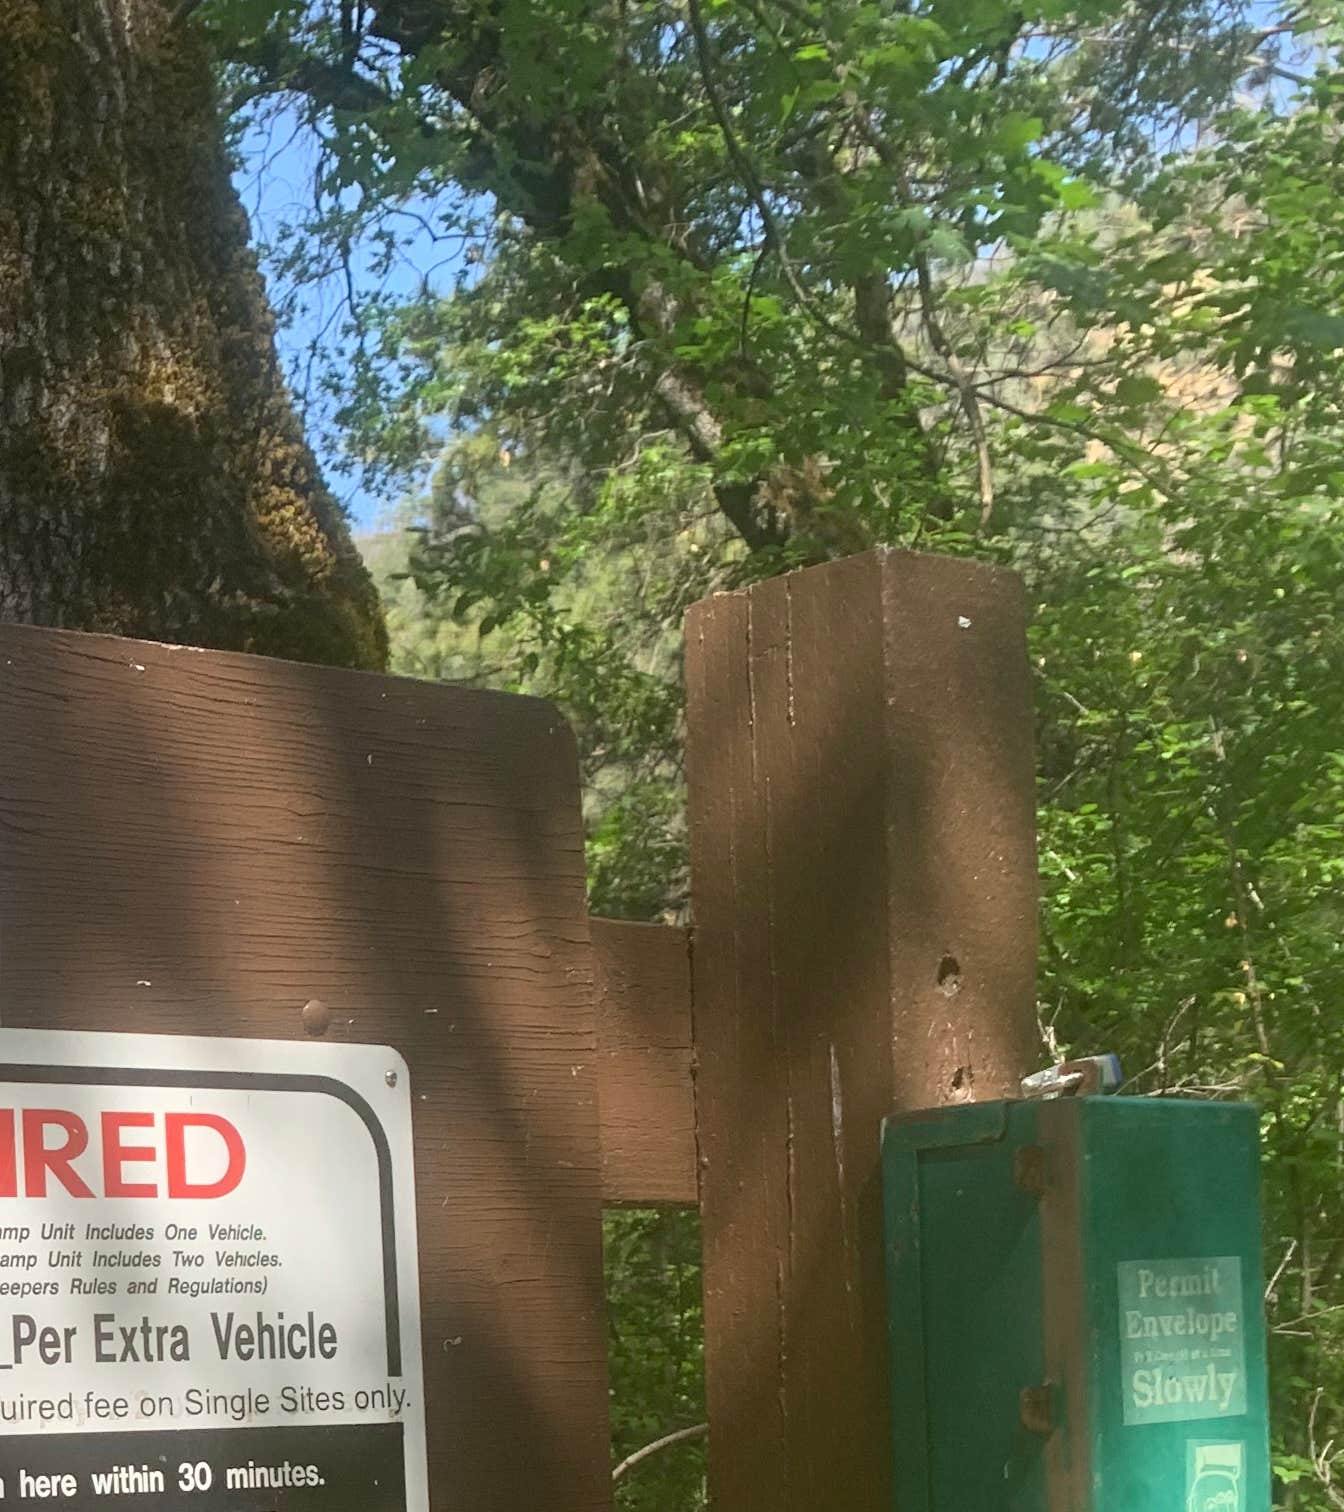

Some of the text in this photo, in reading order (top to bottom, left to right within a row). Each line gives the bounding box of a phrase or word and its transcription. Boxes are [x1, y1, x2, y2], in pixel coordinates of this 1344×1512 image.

[41, 1224, 75, 1240] Unit
[86, 1224, 154, 1240] Includes
[165, 1224, 197, 1240] One
[209, 1224, 266, 1240] Vehicle.
[1136, 1265, 1219, 1298] Permit
[12, 1314, 77, 1365] Per
[94, 1313, 190, 1362] Extra
[210, 1312, 338, 1362] Vehicle
[1127, 1308, 1237, 1340] Envelope
[84, 1392, 128, 1418] fee
[140, 1397, 173, 1416] on
[186, 1388, 269, 1420] Single
[280, 1386, 344, 1413] Sites
[355, 1382, 411, 1418] only.
[1133, 1363, 1236, 1412] Slowly
[20, 1470, 76, 1497] here
[92, 1465, 164, 1494] within
[178, 1462, 212, 1491] 30
[227, 1461, 324, 1489] minutes.
